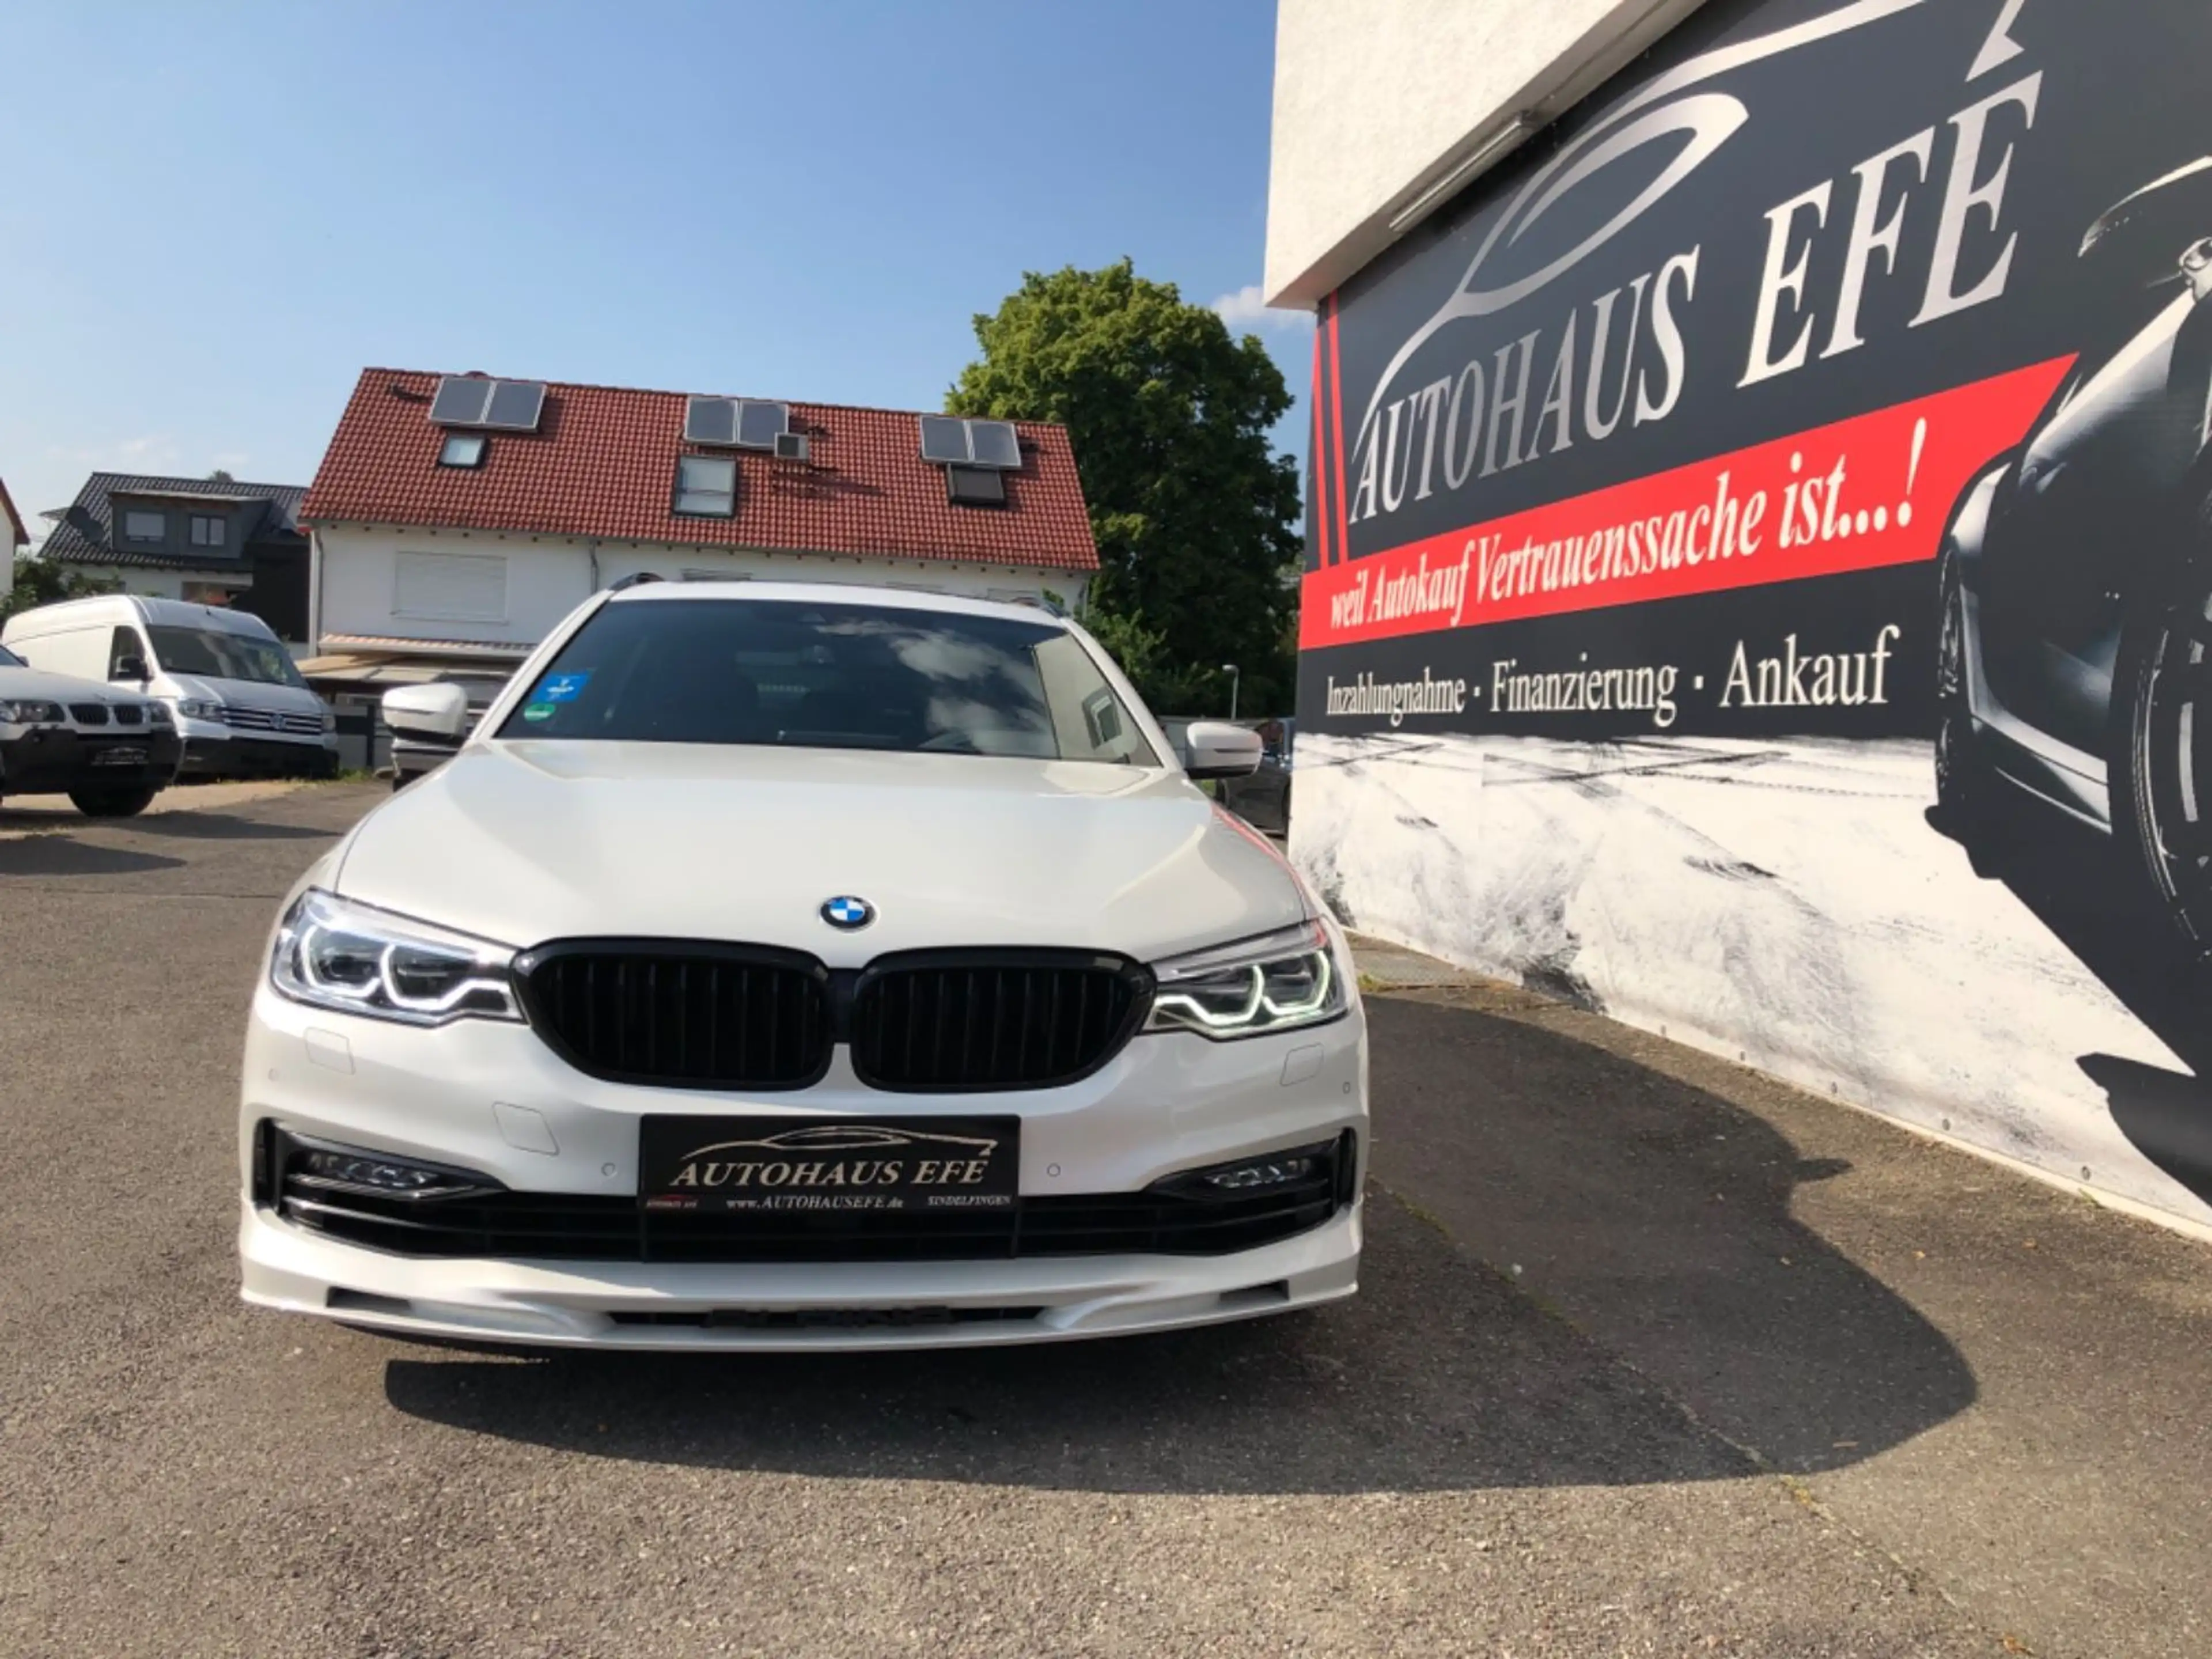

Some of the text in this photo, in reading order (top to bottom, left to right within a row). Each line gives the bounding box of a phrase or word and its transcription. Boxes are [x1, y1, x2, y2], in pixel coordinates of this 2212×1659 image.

[1348, 69, 2044, 525] AUTOHAUS EFE
[1331, 417, 1927, 628] weil Autokauf Vertrauenssache ist...!
[1326, 624, 1900, 728] Inzahlungnahme Finanzierung Ankauf
[670, 1159, 988, 1186] AUTOHAUS EFE
